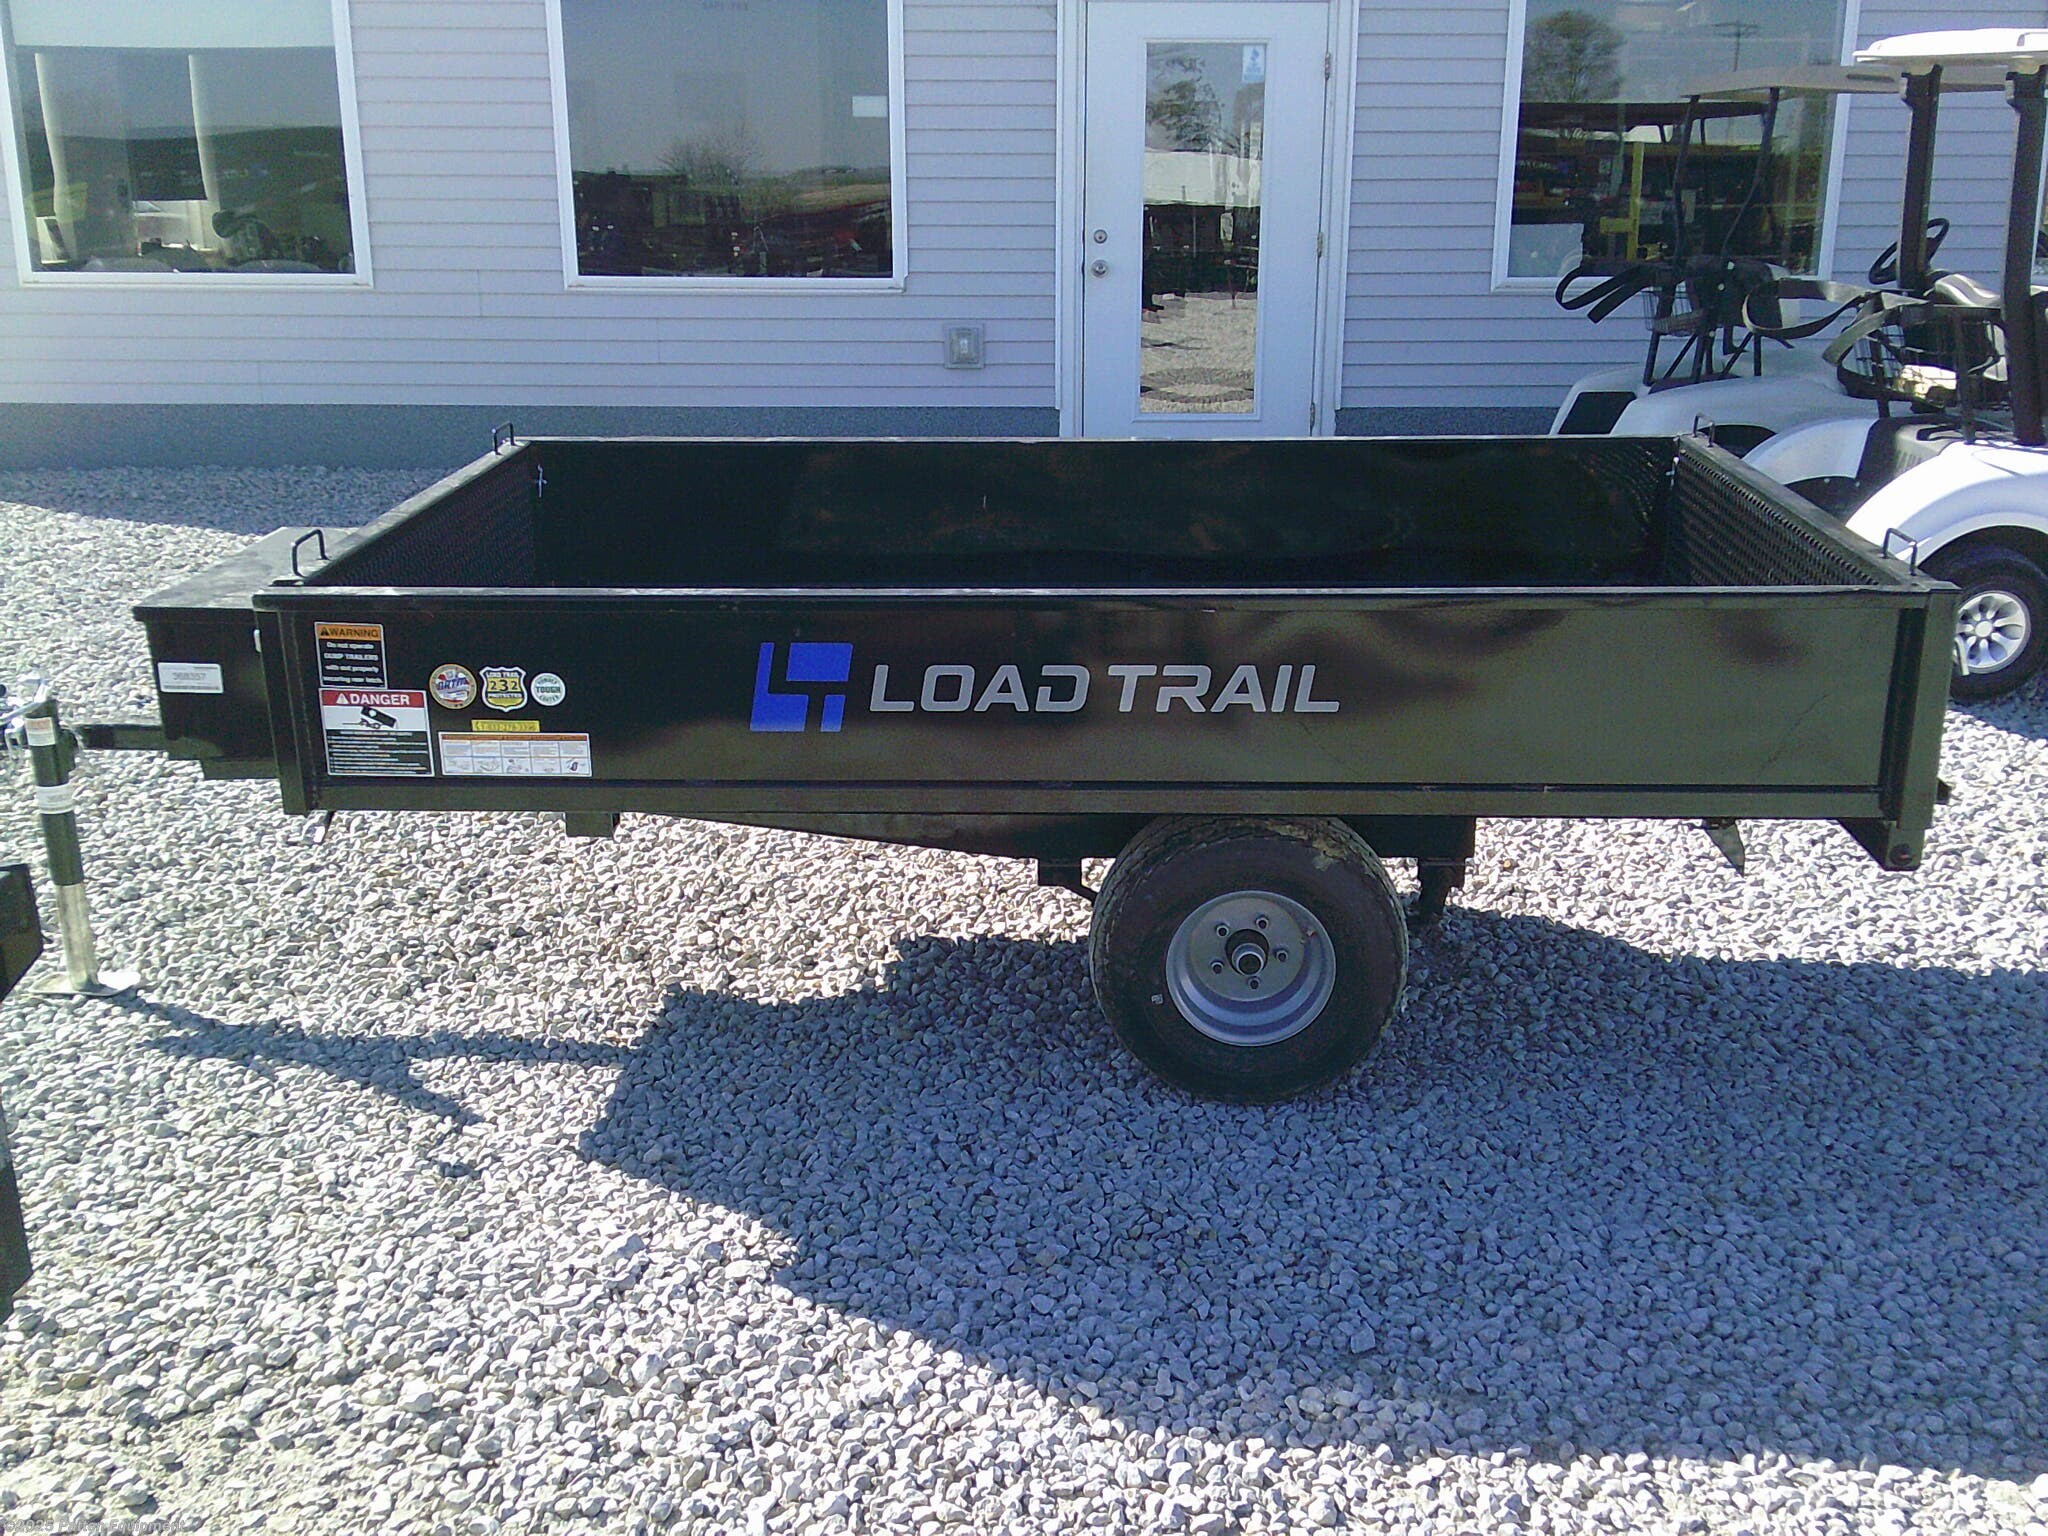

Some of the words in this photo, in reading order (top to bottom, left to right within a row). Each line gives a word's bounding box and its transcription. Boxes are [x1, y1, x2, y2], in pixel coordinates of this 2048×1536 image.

[329, 628, 379, 639] WARNING
[870, 664, 1091, 713] LOAD
[1107, 664, 1341, 714] TRAIL
[349, 693, 410, 705] DANGER
